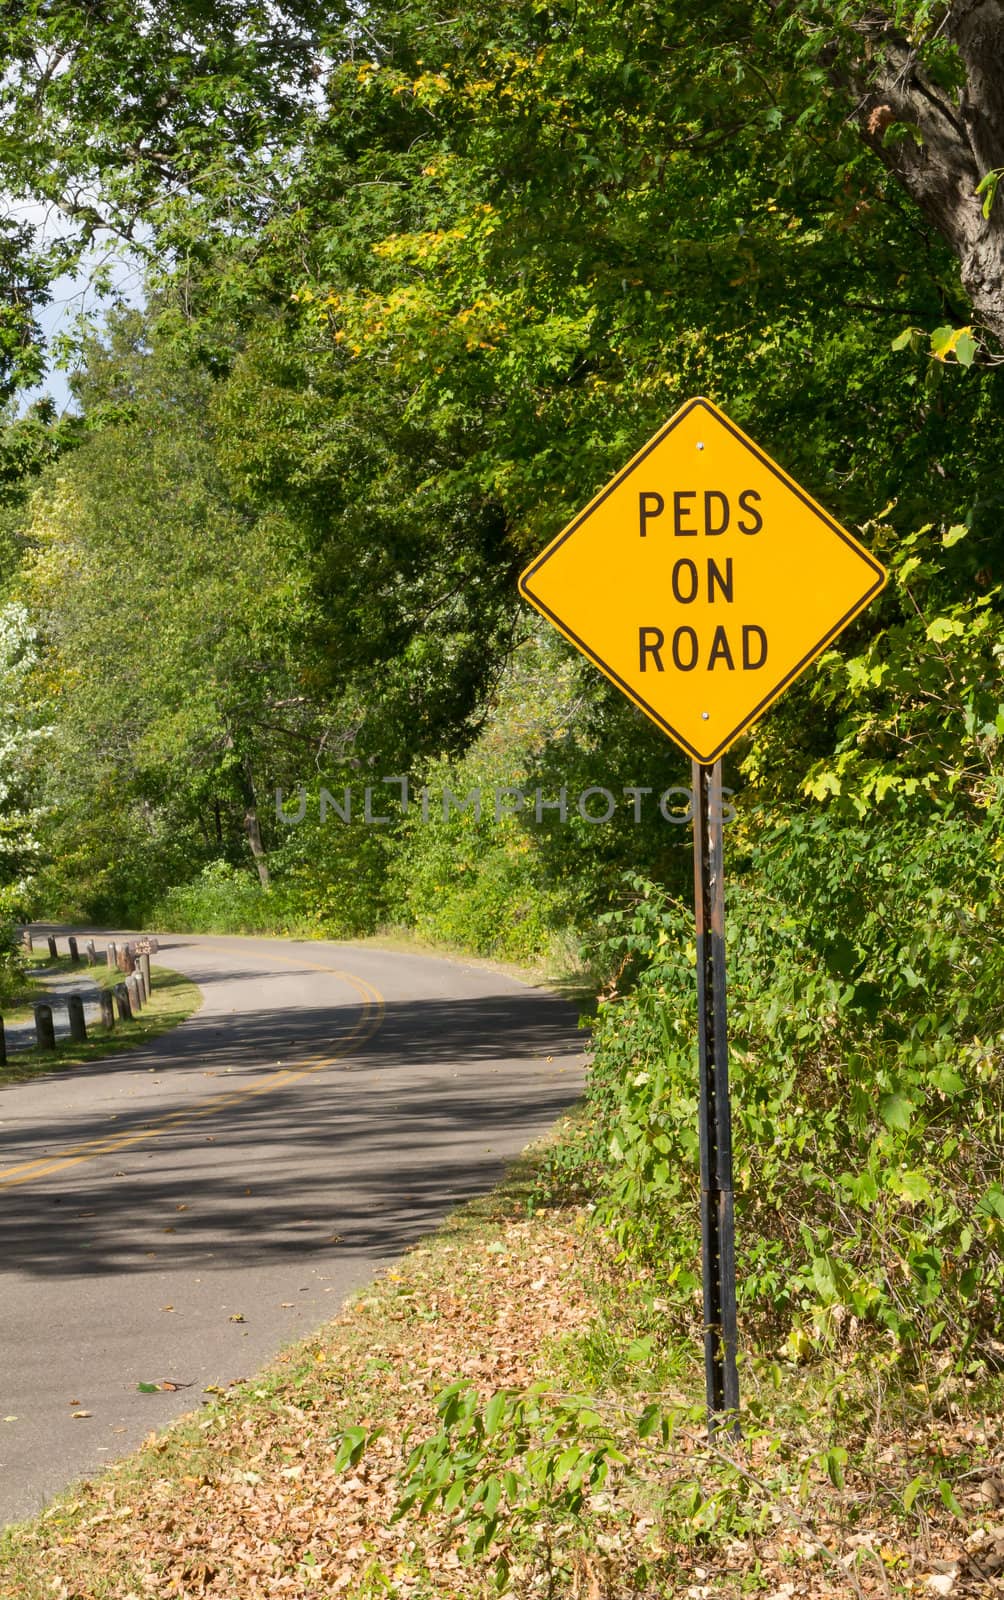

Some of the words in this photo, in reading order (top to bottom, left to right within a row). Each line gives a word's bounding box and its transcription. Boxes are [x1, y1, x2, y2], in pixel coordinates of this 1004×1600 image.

[639, 489, 763, 537] PEDS
[671, 557, 734, 604] ON
[638, 624, 769, 673] ROAD
